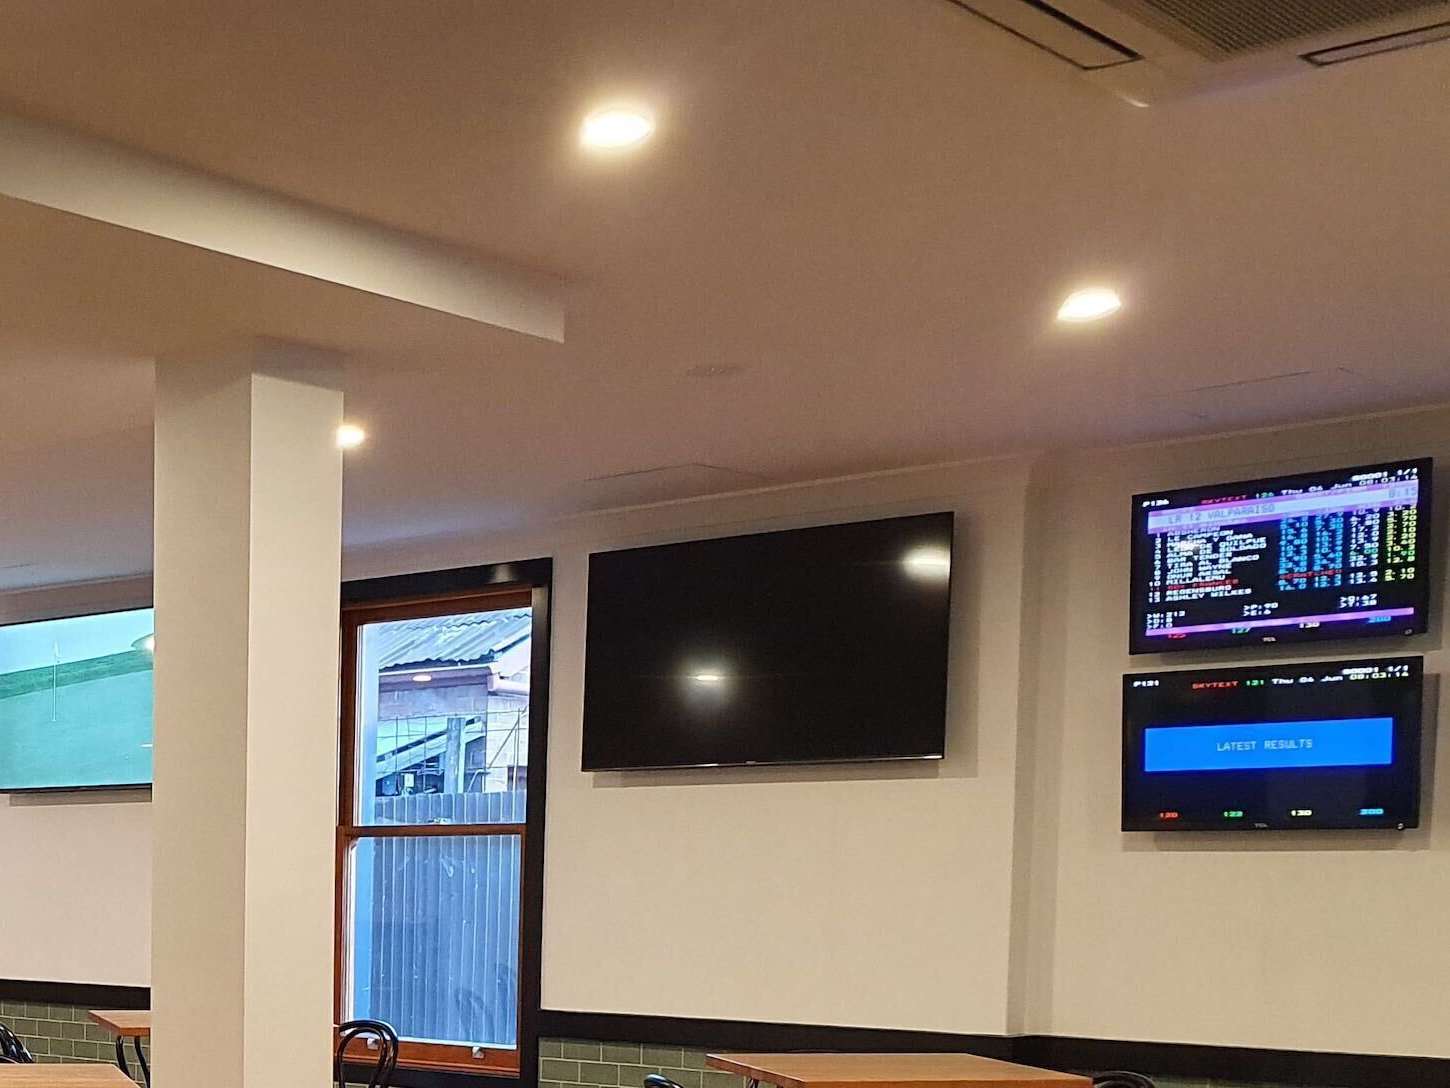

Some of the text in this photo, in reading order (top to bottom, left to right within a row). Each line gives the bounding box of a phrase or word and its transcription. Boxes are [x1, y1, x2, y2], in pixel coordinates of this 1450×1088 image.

[1169, 515, 1181, 524] LR
[1191, 513, 1201, 521] 12
[1208, 503, 1275, 519] VALPARAISO
[1192, 680, 1238, 690] SKYTEXT
[1321, 674, 1342, 682] Jun
[1217, 739, 1312, 752] LATEST RESULTS
